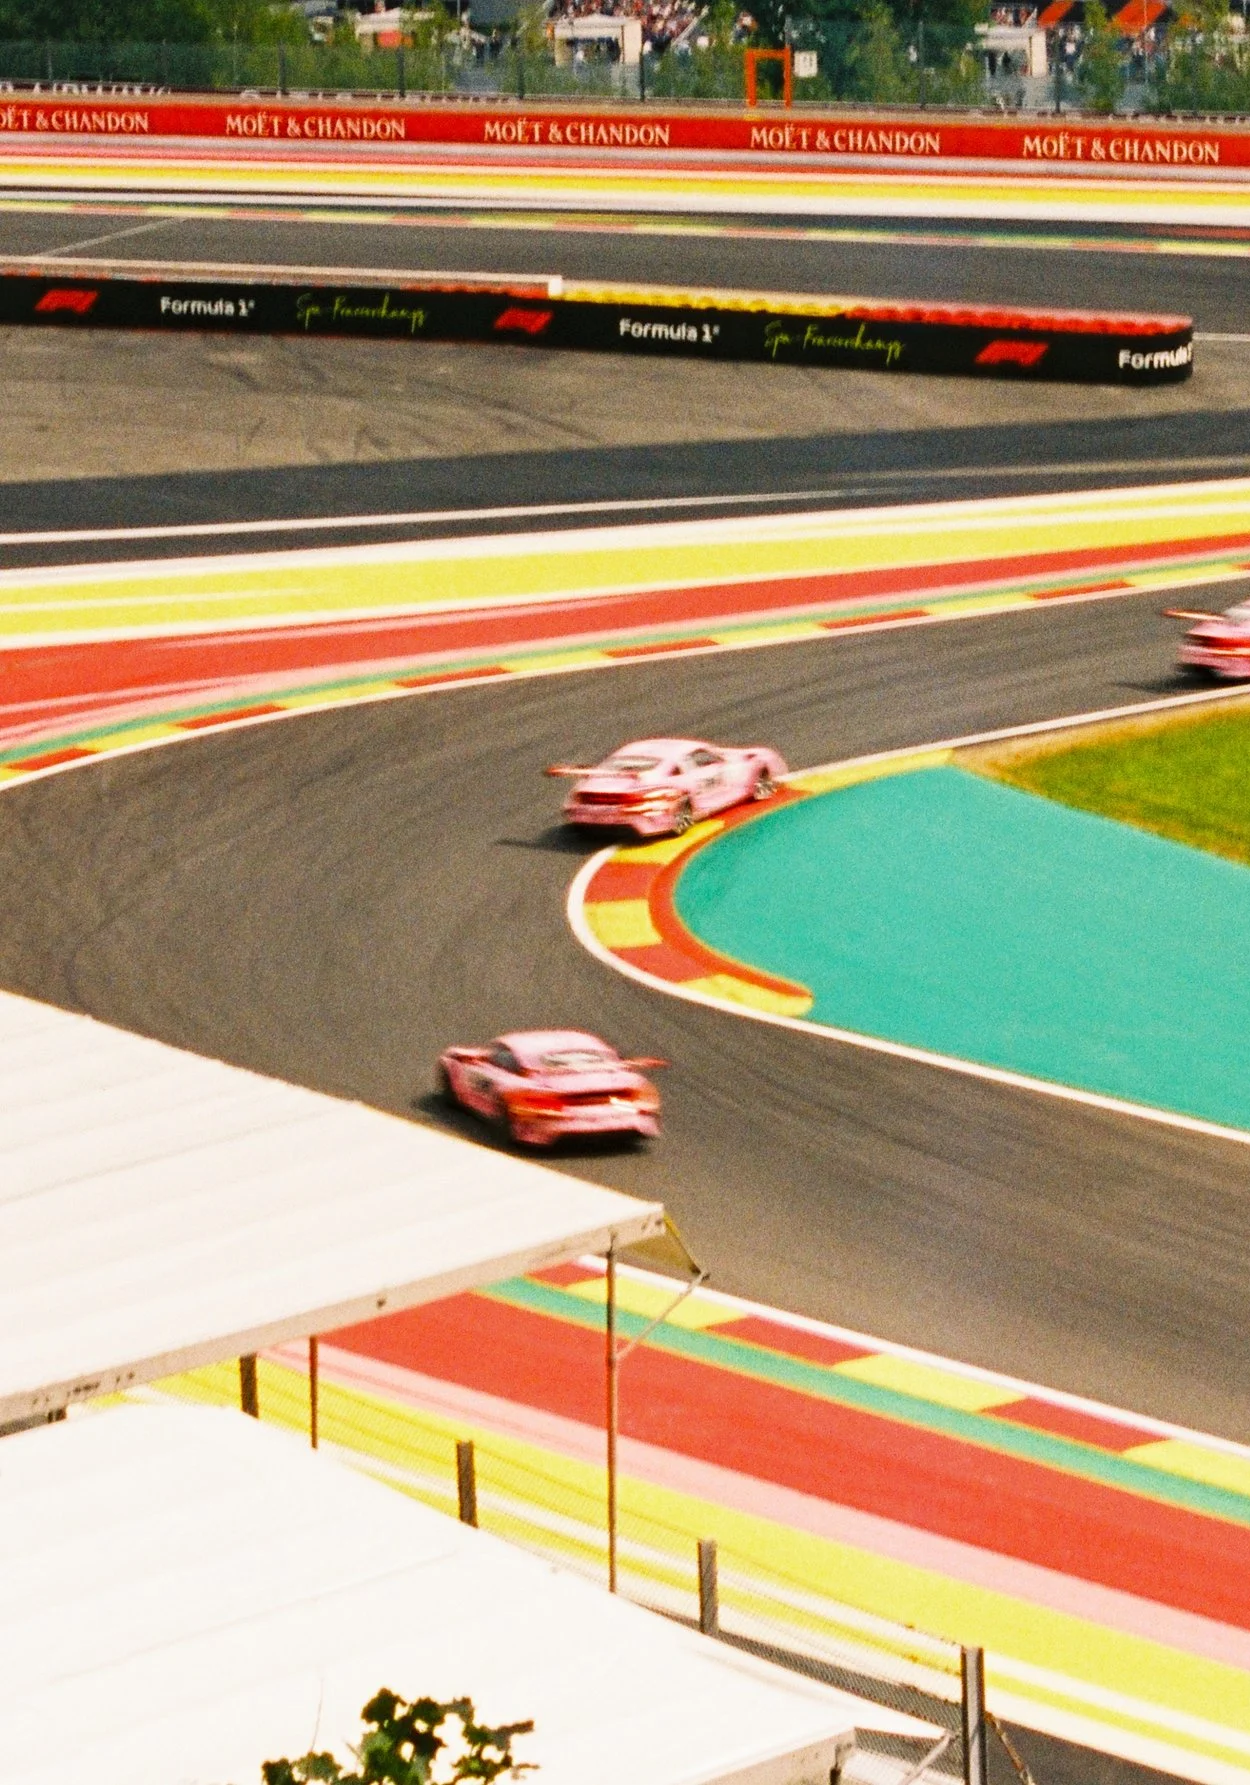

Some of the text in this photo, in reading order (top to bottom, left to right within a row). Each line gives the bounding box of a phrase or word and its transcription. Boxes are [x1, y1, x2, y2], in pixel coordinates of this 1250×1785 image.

[0, 105, 149, 131] ËT & CHANDON
[227, 111, 405, 139] MOËT & CHANDON
[485, 117, 669, 146] MOËT & CHANDON
[752, 123, 940, 154] MOËT & CHANDON
[1024, 132, 1219, 163] MOËT & CHANDON
[160, 296, 235, 316] Formula
[619, 318, 697, 342] Formula
